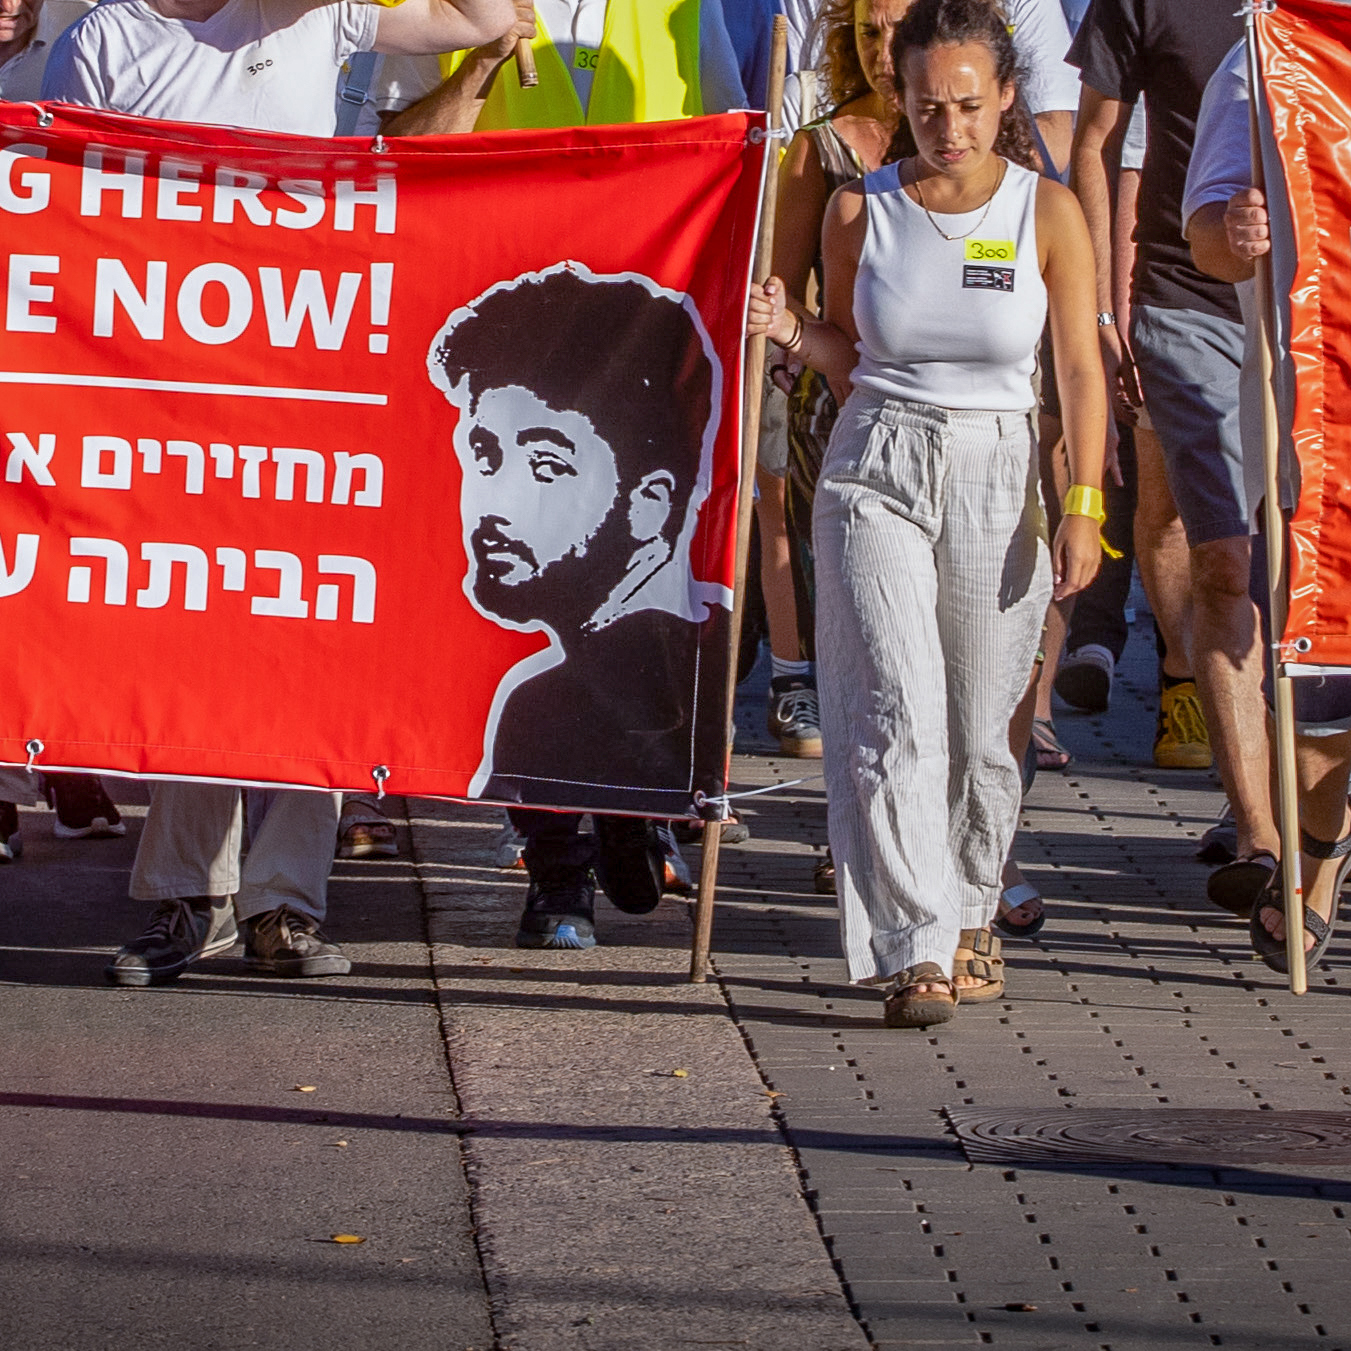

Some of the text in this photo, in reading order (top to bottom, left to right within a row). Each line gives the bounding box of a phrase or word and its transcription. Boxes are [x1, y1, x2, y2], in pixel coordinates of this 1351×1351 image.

[247, 59, 274, 76] 300
[578, 50, 599, 69] 30
[80, 143, 397, 234] HERSH
[971, 242, 1008, 259] 300
[92, 258, 395, 355] NOW!
[81, 435, 384, 508] מחזירים
[67, 536, 377, 624] הביתה
